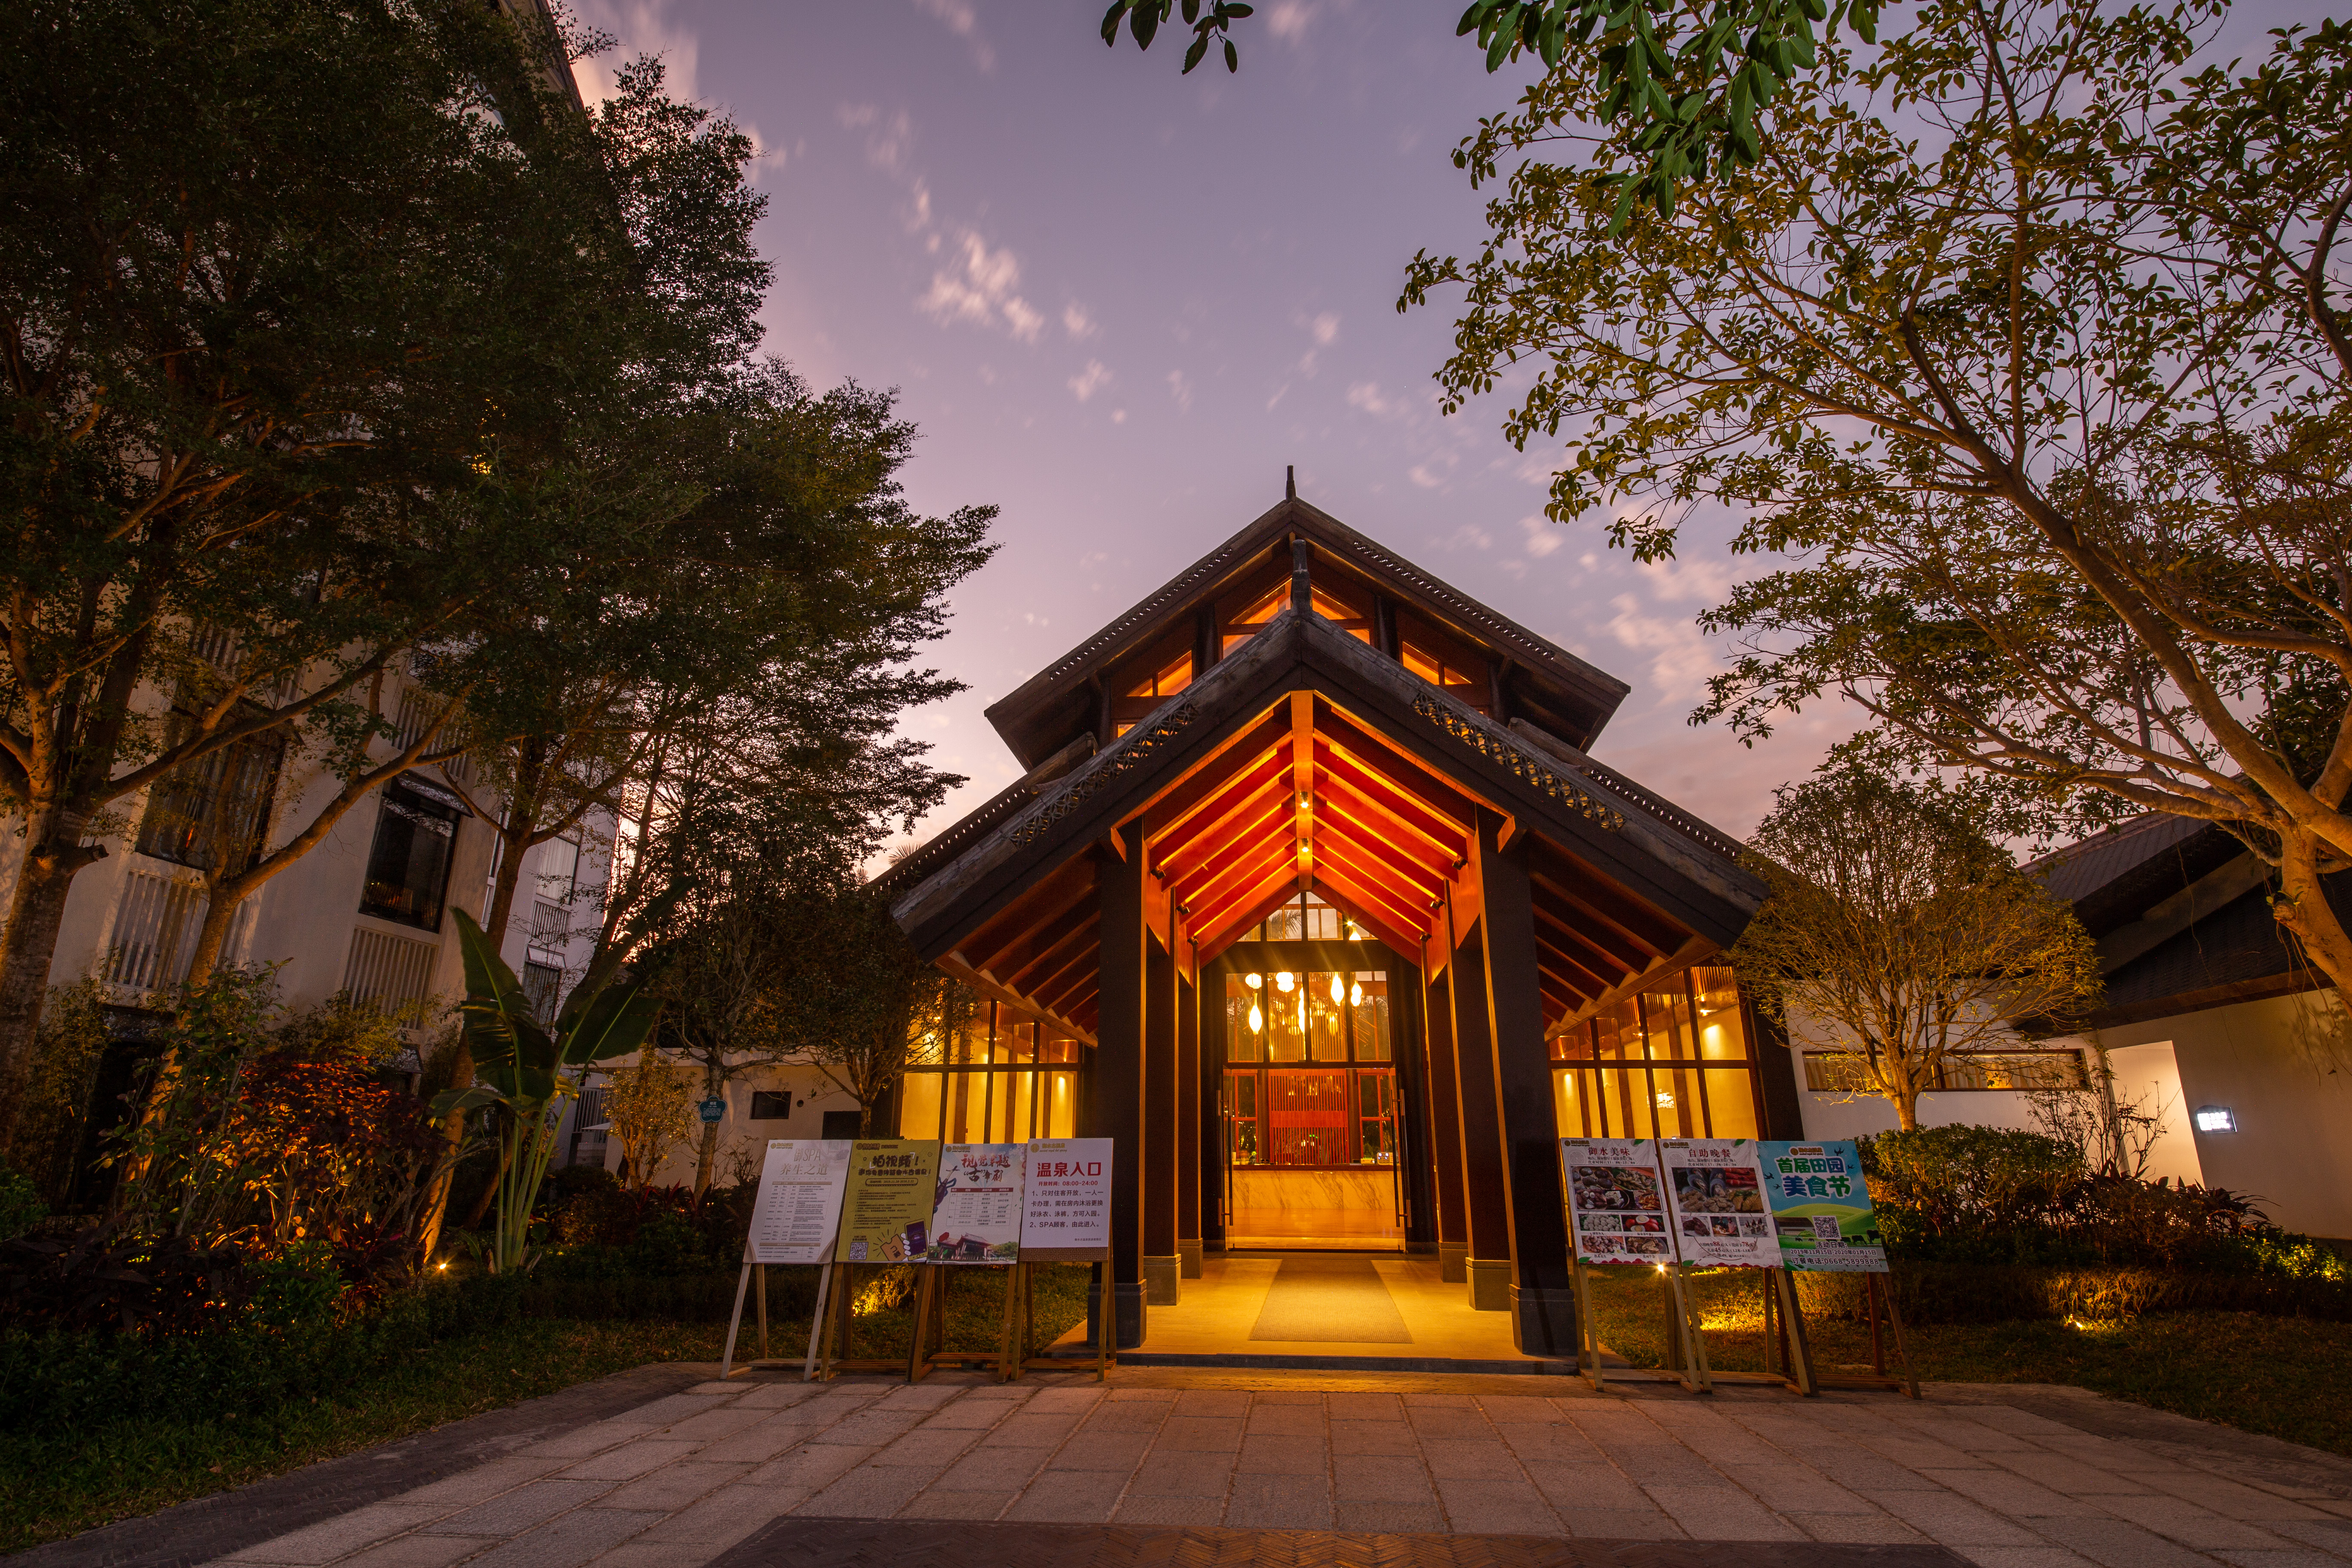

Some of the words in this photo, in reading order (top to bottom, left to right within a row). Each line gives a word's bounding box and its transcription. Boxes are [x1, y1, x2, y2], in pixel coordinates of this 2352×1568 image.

[794, 1148, 821, 1161] 御SPA
[1588, 1147, 1630, 1156] 御水美味
[1689, 1148, 1730, 1158] 自助晚餐
[961, 1154, 1011, 1168] 视觉穿越
[1776, 1157, 1845, 1173] 首届田园
[780, 1163, 828, 1175] 养生之道
[1037, 1162, 1101, 1177] 温泉入口
[1782, 1175, 1850, 1197] 美食节
